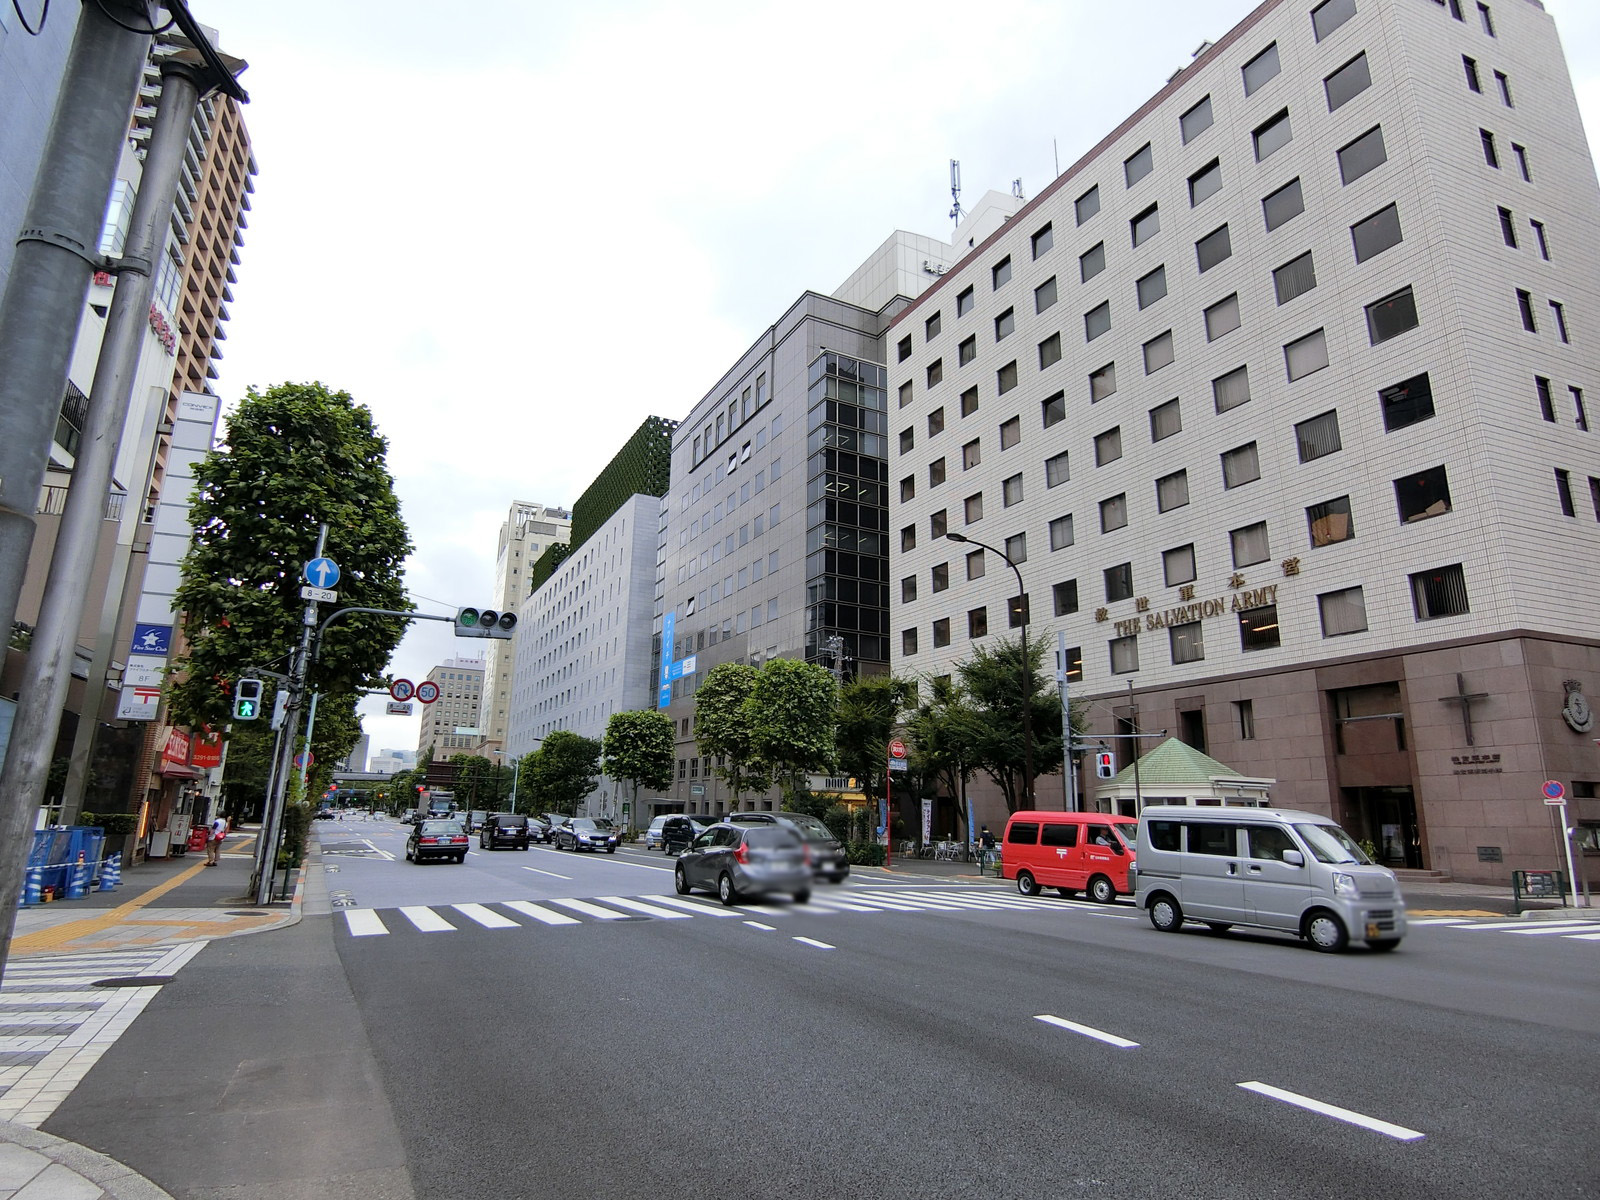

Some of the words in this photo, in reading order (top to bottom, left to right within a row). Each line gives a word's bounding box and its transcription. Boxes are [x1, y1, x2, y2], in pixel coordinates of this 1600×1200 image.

[1094, 556, 1300, 623] 救世軍本営
[1113, 617, 1141, 637] THE
[1146, 596, 1225, 631] SALVATION
[1231, 584, 1278, 612] ARMY
[421, 686, 435, 698] 50
